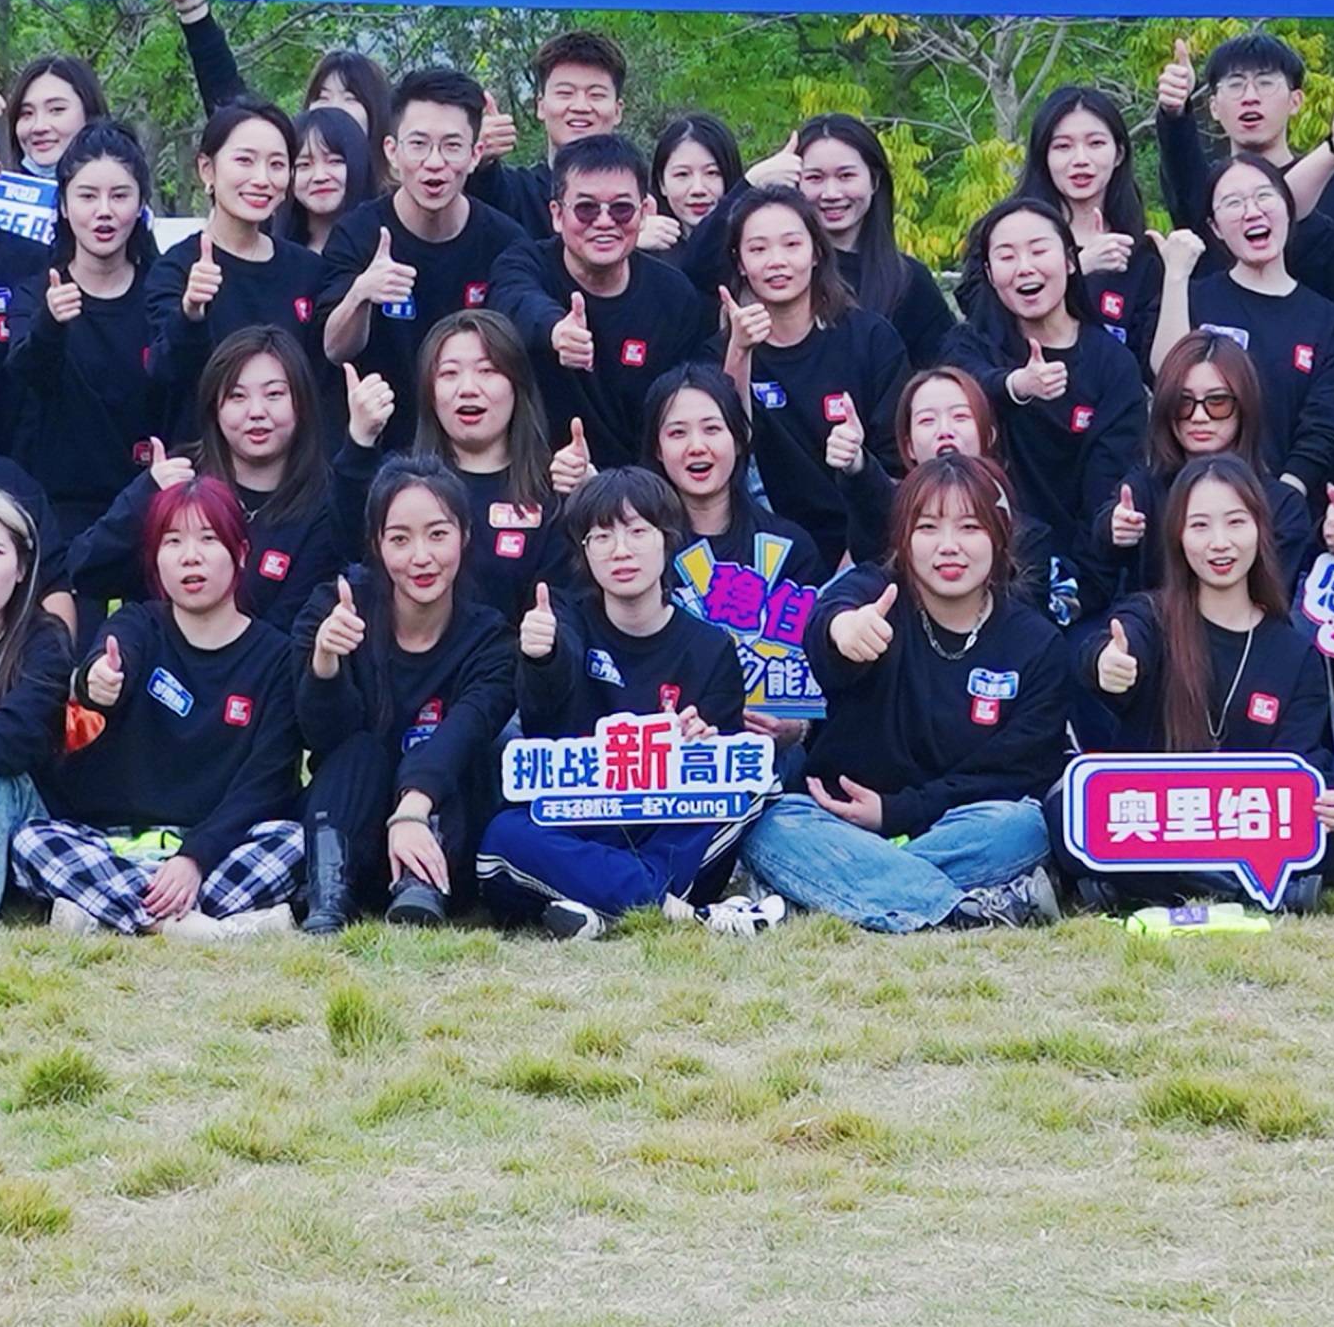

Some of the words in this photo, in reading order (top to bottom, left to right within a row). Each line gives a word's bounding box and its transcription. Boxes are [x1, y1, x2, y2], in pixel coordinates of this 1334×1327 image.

[704, 562, 819, 647] 稳住
[512, 721, 765, 791] 挑战新高度
[1106, 787, 1292, 843] 奥里给!
